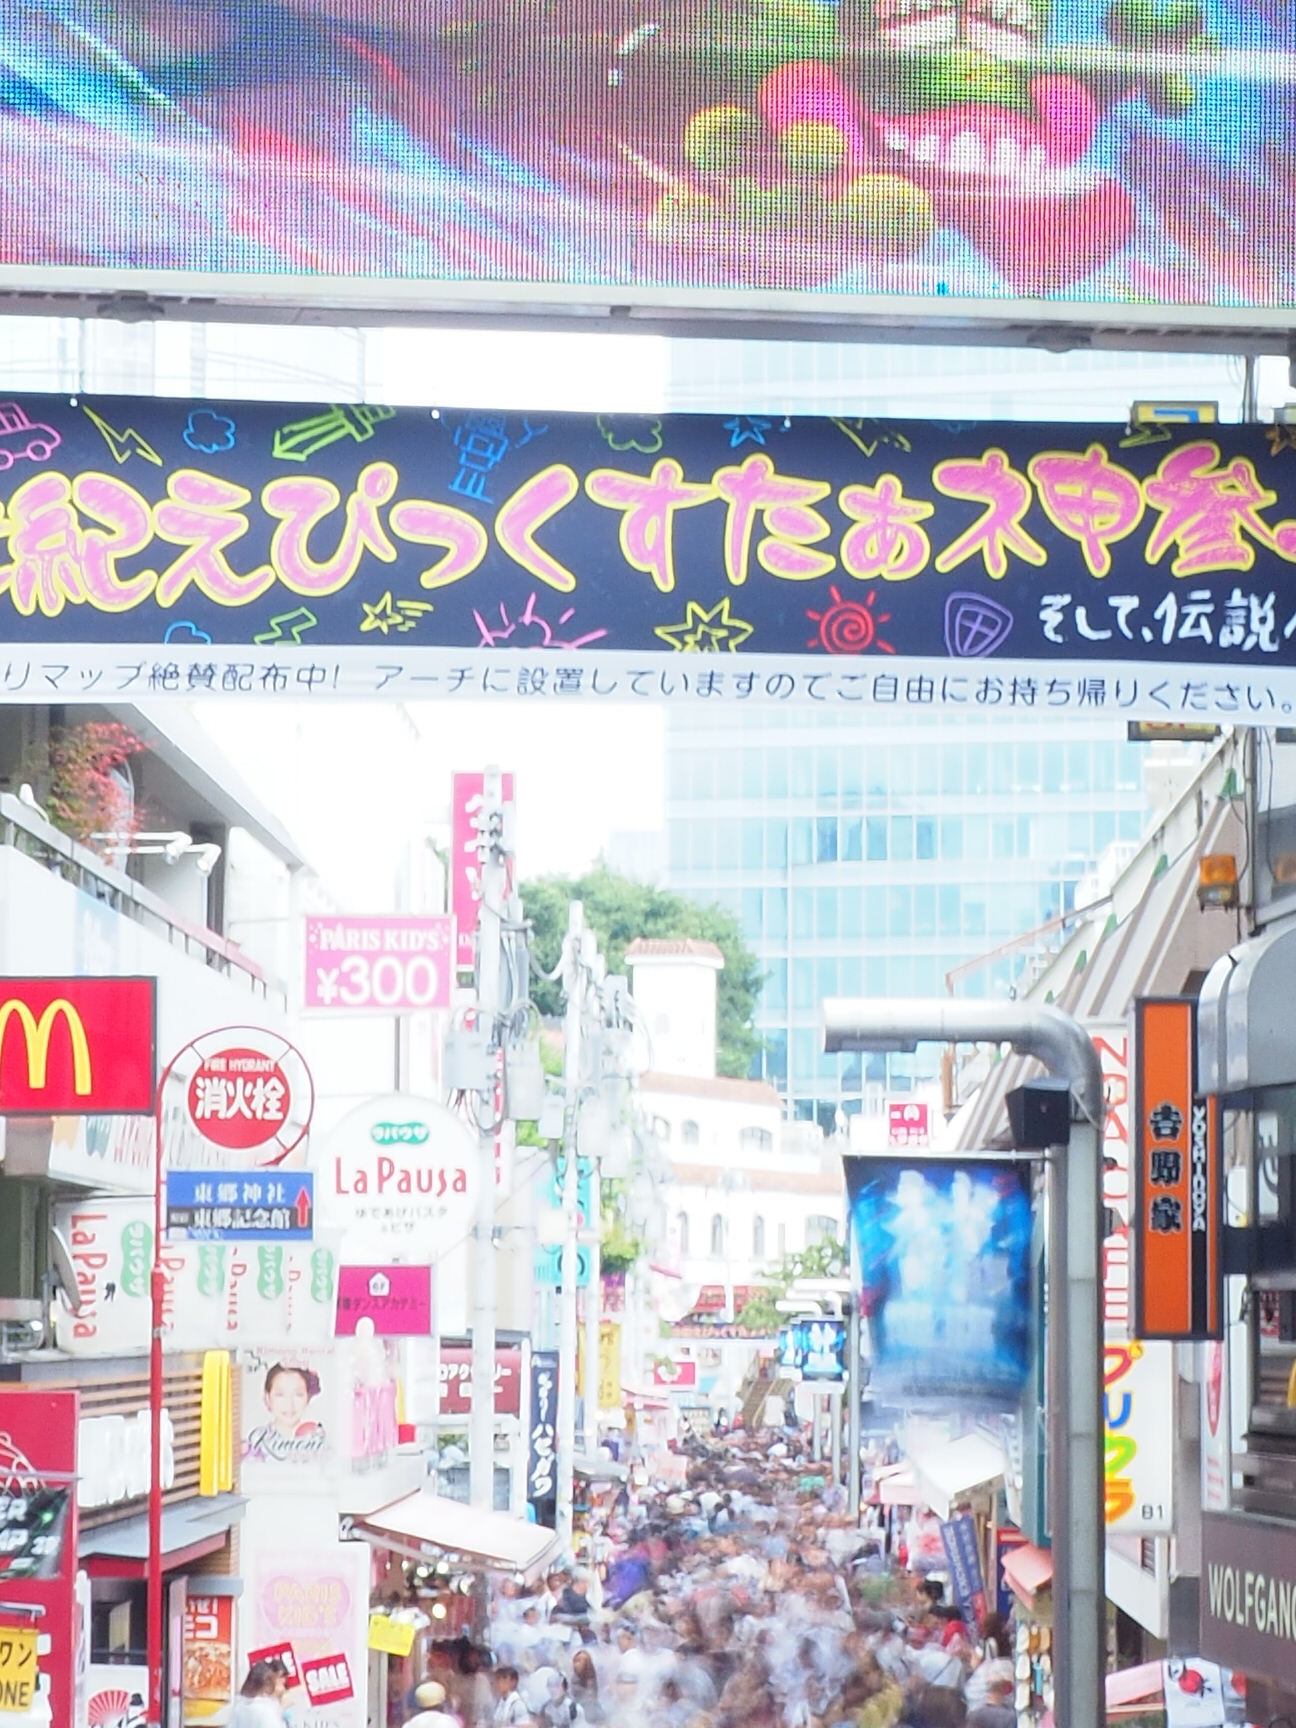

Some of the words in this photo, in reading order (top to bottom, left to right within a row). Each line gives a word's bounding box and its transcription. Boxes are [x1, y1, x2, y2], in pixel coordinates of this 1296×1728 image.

[319, 920, 381, 952] PARIS
[317, 955, 439, 1007] ¥300
[195, 1075, 286, 1121] 消火栓
